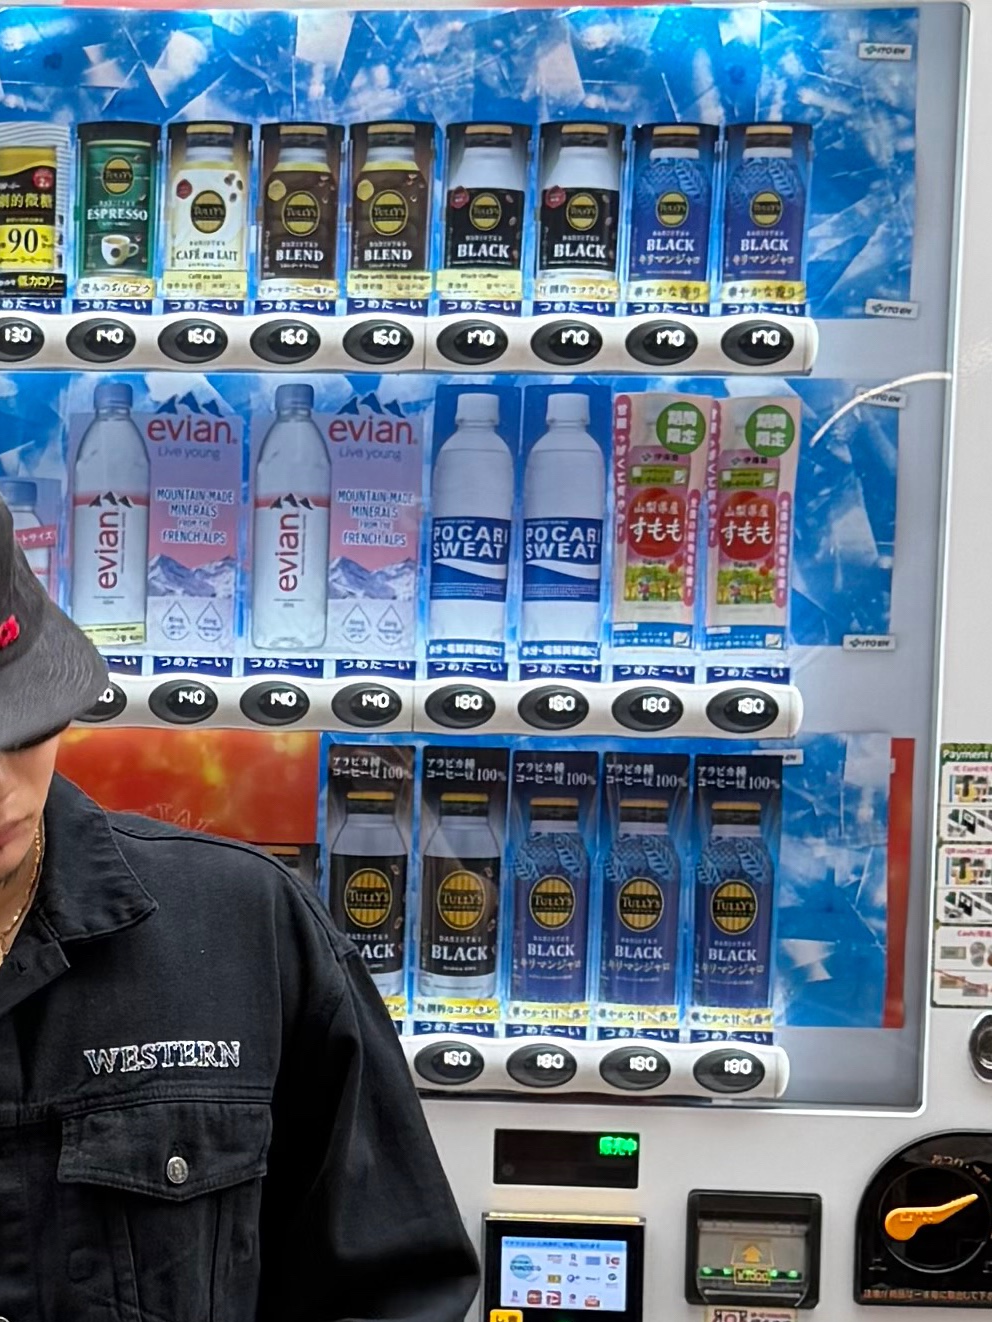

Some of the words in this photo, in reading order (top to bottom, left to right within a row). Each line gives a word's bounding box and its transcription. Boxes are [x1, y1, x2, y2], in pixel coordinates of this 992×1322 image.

[87, 208, 148, 221] ESPRESSO
[8, 228, 39, 254] 90
[647, 239, 694, 251] BLACK
[741, 239, 788, 251] BLACK
[176, 247, 201, 262] CAFÉ
[203, 251, 215, 260] au
[216, 250, 239, 262] LAIT
[276, 249, 324, 262] BLEND
[364, 249, 413, 262] BLEND
[457, 244, 510, 258] BLACK
[553, 244, 606, 259] BLACK
[639, 254, 700, 265] キリマンジャロ
[733, 254, 795, 265] キリマンジャロ
[5, 327, 32, 342] 130
[97, 328, 123, 343] 140
[188, 328, 216, 344] 160
[281, 328, 308, 344] 160
[147, 415, 232, 444] evian
[328, 415, 413, 444] evian
[666, 427, 698, 445] 限定
[755, 430, 786, 447] 限定
[159, 447, 182, 457] Live
[184, 448, 220, 461] young
[339, 447, 363, 457] Live
[365, 448, 401, 462] young
[169, 504, 218, 517] MINERALS
[351, 506, 398, 518] MINERALS
[634, 501, 679, 515] 山梨県産
[724, 503, 769, 517] 山梨県産
[433, 525, 507, 544] POCARI
[525, 526, 601, 544] POCARI
[630, 516, 683, 543] すもも
[721, 520, 773, 547] すもも
[162, 531, 201, 544] FRENCH
[203, 531, 226, 544] ALPS
[343, 532, 381, 545] FRENCH
[383, 533, 406, 546] ALPS
[94, 510, 119, 590] evian
[275, 512, 300, 592] evian
[433, 541, 503, 559] SWEAT
[525, 542, 596, 559] SWEAT
[179, 690, 206, 704] 140
[362, 693, 389, 708] 140
[333, 756, 381, 768] アラビカ種
[943, 750, 984, 761] Payment
[427, 758, 475, 770] アラビカ種
[516, 762, 565, 773] アラビカ種
[606, 763, 654, 775] アラビカ種
[697, 766, 747, 778] アラビカ種
[360, 943, 395, 959] ACK
[431, 945, 488, 961] BLACK
[527, 943, 575, 957] BLACK
[615, 945, 663, 959] BLACK
[708, 948, 757, 962] BLACK
[519, 958, 582, 970] キリマンジャロ
[608, 960, 670, 972] キリマンジャロ
[701, 963, 764, 975] キリマンジャロ
[83, 1041, 240, 1075] WESTERN
